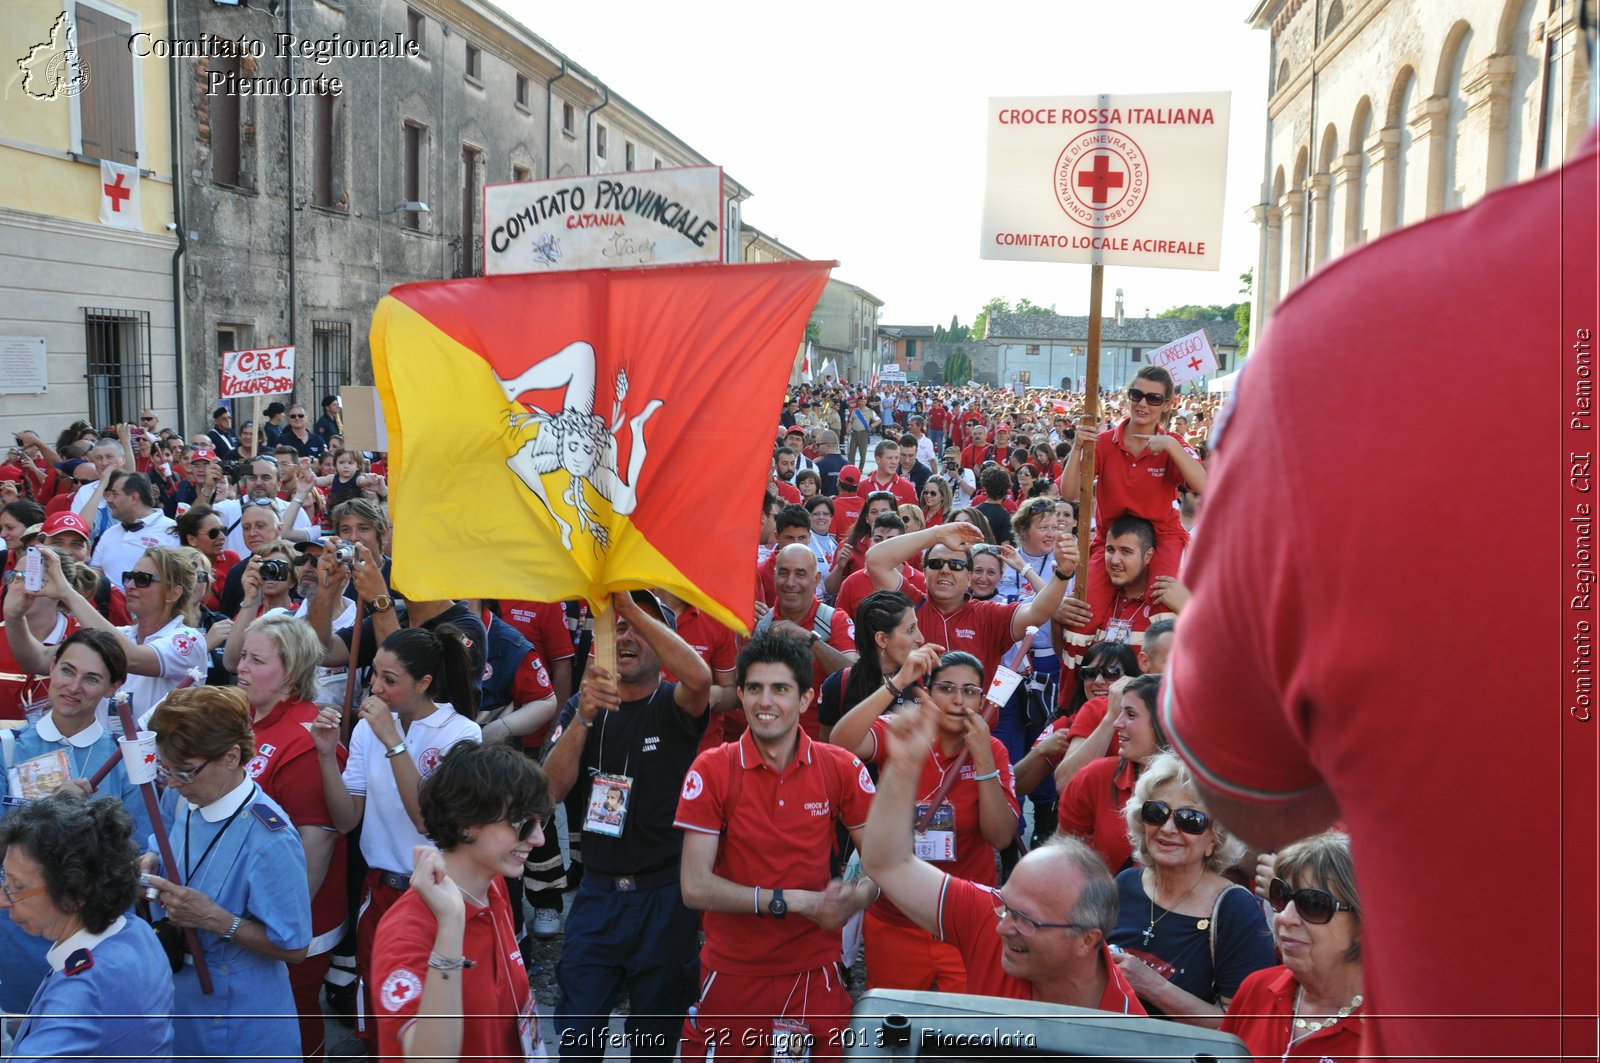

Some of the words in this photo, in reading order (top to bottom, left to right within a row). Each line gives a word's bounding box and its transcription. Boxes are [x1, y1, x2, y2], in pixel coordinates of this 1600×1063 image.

[998, 108, 1057, 125] CROCE
[1061, 108, 1122, 124] ROSSA
[1127, 108, 1215, 124] ITALIANA
[1071, 144, 1081, 156] DI
[1082, 135, 1127, 151] GINEVRA
[1126, 148, 1138, 161] 22
[1059, 155, 1093, 221] CONVENZIONE
[1126, 162, 1143, 207] AGOSTO
[491, 186, 585, 254] COMITATO
[594, 180, 718, 248] PROVINCIALE
[566, 213, 625, 229] CATANIA
[1104, 206, 1127, 222] 1864
[995, 232, 1069, 248] COMITATO
[1072, 236, 1129, 251] LOCALE
[1132, 238, 1206, 256] ACIREALE
